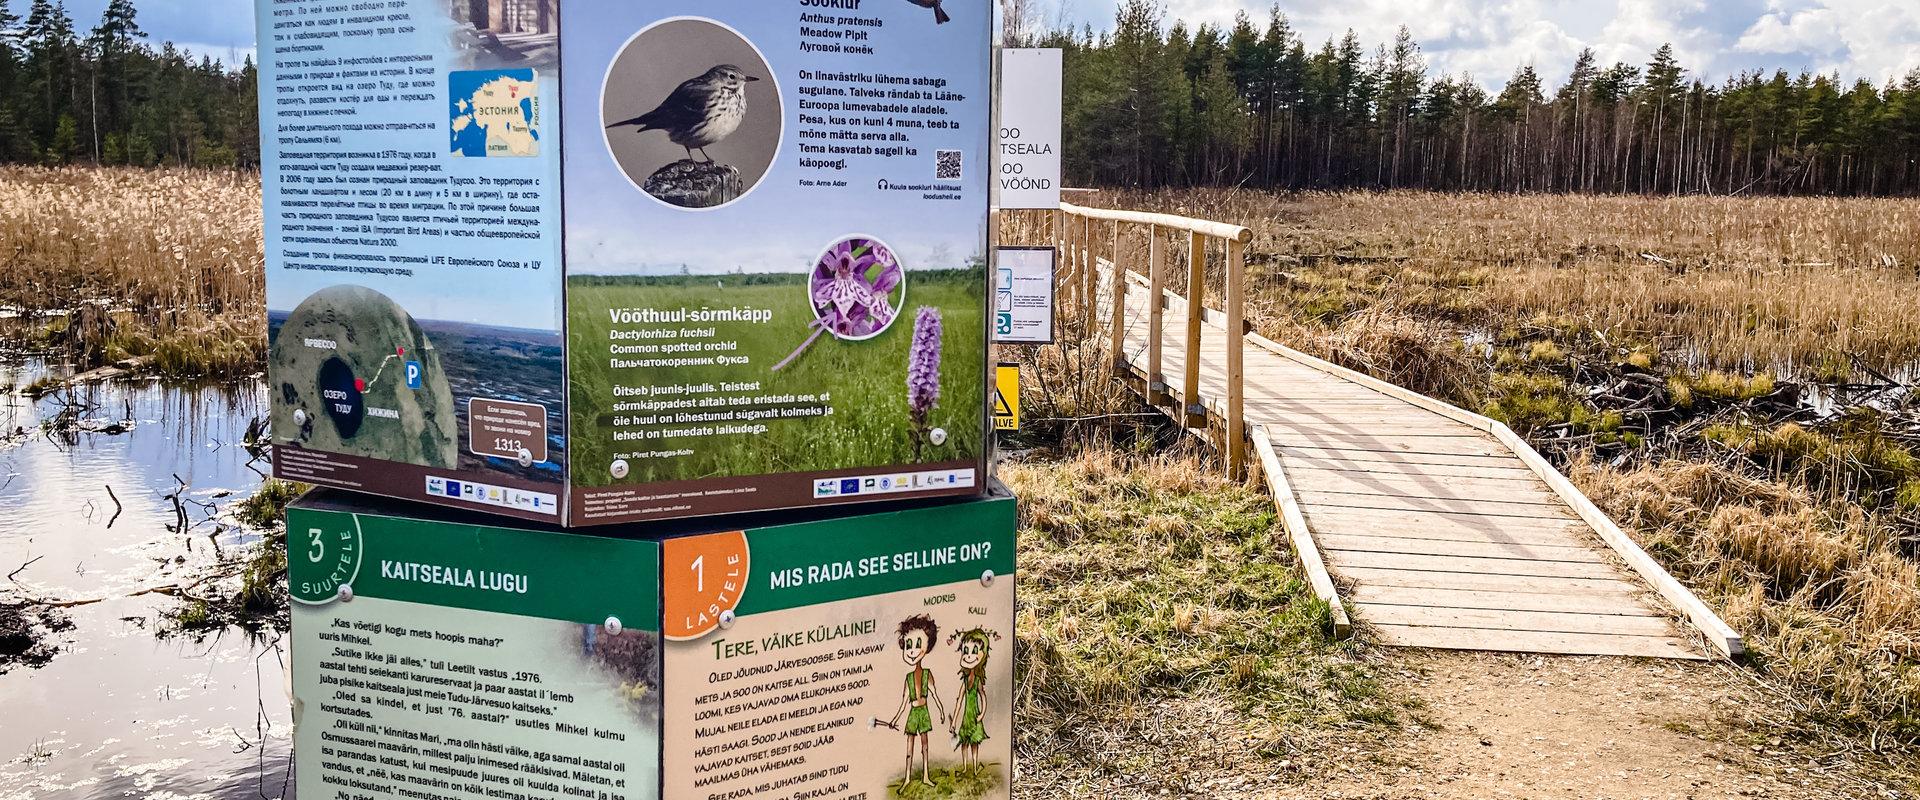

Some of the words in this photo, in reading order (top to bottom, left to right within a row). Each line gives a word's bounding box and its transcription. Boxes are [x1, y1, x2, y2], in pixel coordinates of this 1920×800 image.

[800, 12, 835, 24] Anthus
[838, 17, 882, 27] pratensis
[800, 27, 842, 38] Meadow
[846, 30, 867, 41] Pipit
[800, 41, 840, 52] Луговой
[844, 45, 873, 54] конёк
[799, 70, 812, 79] On
[816, 71, 872, 82] linavästriku
[875, 74, 910, 84] lühema
[912, 77, 946, 88] sabaga
[799, 86, 846, 96] sugulane.
[849, 87, 885, 98] Talveks
[888, 89, 920, 99] rändab
[923, 91, 932, 100] ta
[935, 91, 966, 101] Lääne-
[480, 107, 518, 116] ЭСТОНИЯ
[800, 100, 839, 112] Euroopa
[843, 102, 908, 113] lumevabadele
[911, 105, 947, 114] aladele.
[800, 114, 826, 125] Pesa,
[829, 115, 846, 125] kus
[864, 117, 884, 126] kuni
[887, 118, 893, 126] 4
[896, 120, 924, 129] muna,
[927, 120, 948, 128] teeb
[950, 120, 959, 129] ta
[800, 129, 826, 138] mõne
[830, 130, 858, 140] mätta
[890, 132, 909, 141] alla.
[799, 143, 825, 153] Tema
[829, 144, 872, 154] kasvatab
[875, 146, 903, 156] sageli
[906, 147, 916, 156] ka
[800, 158, 847, 170] käopoegi.
[1000, 163, 1023, 174] OO
[609, 306, 772, 323] Vööthuul-sõrmkäpp
[610, 329, 677, 340] Dactylorhiza
[680, 328, 715, 337] fuchsii
[304, 338, 336, 349] ЯРВЕСОО
[610, 344, 658, 354] Common
[661, 342, 701, 353] spotted
[704, 341, 736, 350] orchid
[611, 358, 714, 368] Пальчатокоренник
[716, 355, 749, 366] Фукса
[324, 390, 347, 400] ОЗЕРО
[613, 385, 648, 396] Õitseb
[650, 383, 717, 396] juunis-juulis.
[720, 381, 760, 391] Teistest
[335, 404, 352, 414] ТУДУ
[613, 398, 696, 411] sõrmkäppadest
[699, 397, 726, 406] aitab
[728, 396, 751, 405] teda
[754, 393, 794, 404] eristada
[797, 392, 817, 402] see,
[820, 392, 830, 401] et
[368, 407, 400, 419] ХИЖИНА
[614, 416, 630, 426] õie
[633, 414, 656, 424] huul
[676, 410, 733, 422] lõhestunud
[736, 408, 778, 420] sügavalt
[781, 406, 822, 417] kolmeks
[824, 406, 834, 417] ja
[614, 430, 643, 440] lehed
[662, 426, 713, 438] tumedate
[716, 424, 768, 435] laikudega.
[494, 438, 521, 452] 1313
[308, 528, 324, 562] 3
[302, 530, 352, 594] SUURTELE
[771, 568, 803, 589] MIS
[808, 561, 854, 584] RADA
[858, 556, 888, 576] SEE
[893, 546, 956, 571] SELLINE
[960, 542, 991, 562] ON?
[382, 560, 475, 588] KAITSEALA
[480, 571, 527, 593] LUGU
[691, 554, 703, 592] 1
[686, 554, 740, 629] LASTELE
[924, 593, 956, 606] MODRIS
[968, 607, 987, 615] KALLI
[319, 633, 340, 641] uuris
[342, 634, 372, 646] Mihkel.
[354, 621, 381, 634] võetigi
[385, 624, 406, 637] kogu
[410, 630, 432, 639] mets
[436, 631, 465, 643] hoopis
[712, 639, 758, 660] TERE,
[762, 632, 803, 652] VÄIKE
[807, 619, 875, 644] KÜLALINE!
[365, 651, 383, 662] ikke
[386, 654, 397, 664] jäi
[430, 660, 444, 670] tuli
[448, 662, 475, 674] Leetilt
[479, 668, 508, 679] vastus
[709, 672, 732, 683] OLED
[734, 664, 773, 679] JÕUDNUD
[774, 653, 835, 672] JÄRVESOOSSE.
[838, 650, 854, 660] SIIN
[855, 644, 884, 656] KASVAV
[320, 662, 345, 671] aastal
[348, 664, 367, 674] tehti
[411, 672, 472, 689] karureservaat
[474, 681, 482, 691] ja
[485, 684, 506, 693] paar
[508, 688, 537, 698] aastat
[695, 694, 718, 705] METS
[720, 691, 731, 700] JA
[733, 687, 750, 698] SOO
[752, 684, 763, 694] ON
[765, 679, 793, 691] KAITSE
[812, 672, 828, 682] SIIN
[830, 670, 840, 679] ON
[842, 666, 862, 676] TAIMI
[863, 664, 873, 673] JA
[321, 703, 372, 718] kortsutades.
